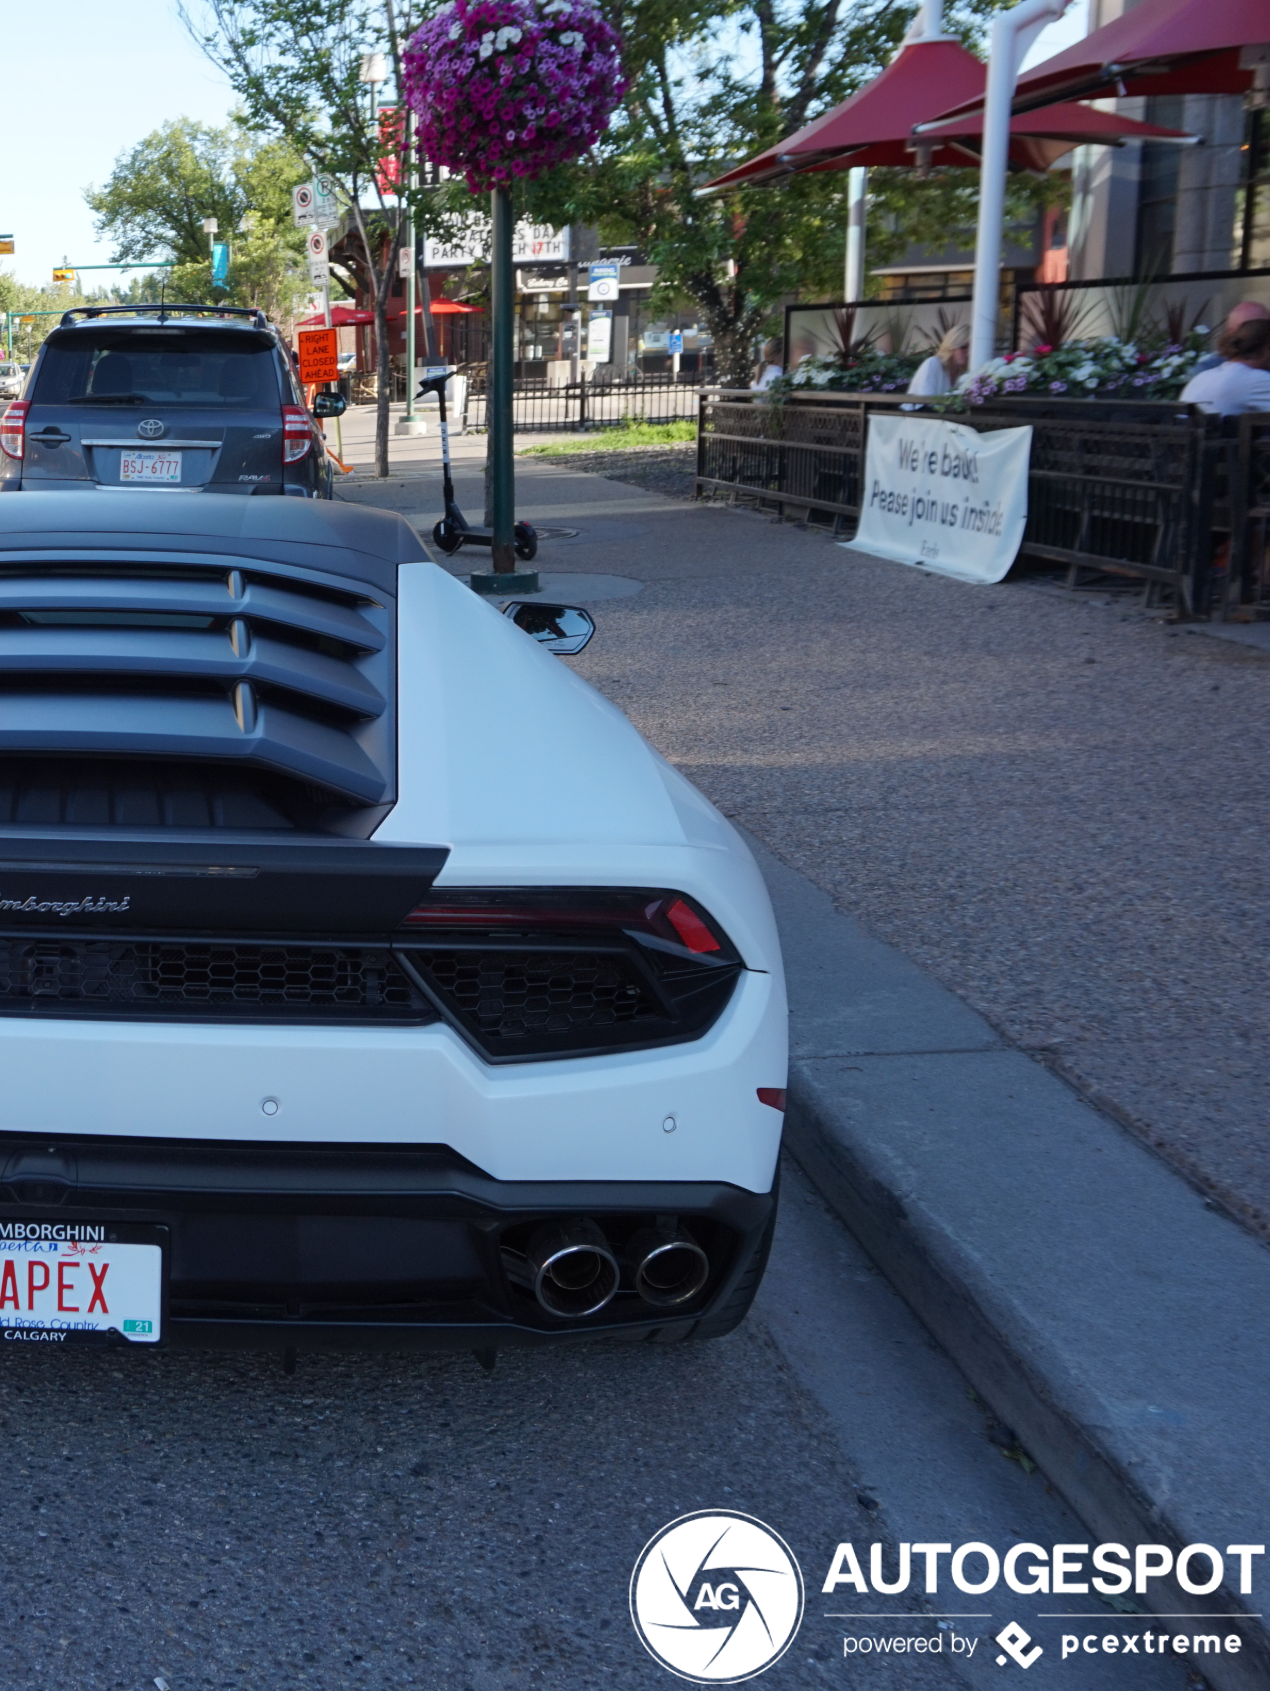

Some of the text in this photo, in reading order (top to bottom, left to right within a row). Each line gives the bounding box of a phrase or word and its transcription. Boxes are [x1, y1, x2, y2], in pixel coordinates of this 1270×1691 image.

[432, 246, 475, 259] PARTY
[532, 241, 561, 254] 17TH
[305, 333, 329, 343] RIGHT
[306, 345, 330, 355] LANE
[302, 356, 335, 367] CLOSED
[305, 368, 334, 379] AHEAD
[899, 438, 939, 475] We're
[122, 460, 179, 474] BSJ-6777
[870, 479, 909, 517] Pease
[908, 488, 937, 527] join
[941, 502, 959, 527] us
[15, 1317, 46, 1328] Rose
[50, 1319, 100, 1330] Country
[135, 1321, 149, 1332] 21
[4, 1330, 67, 1341] CALGARY
